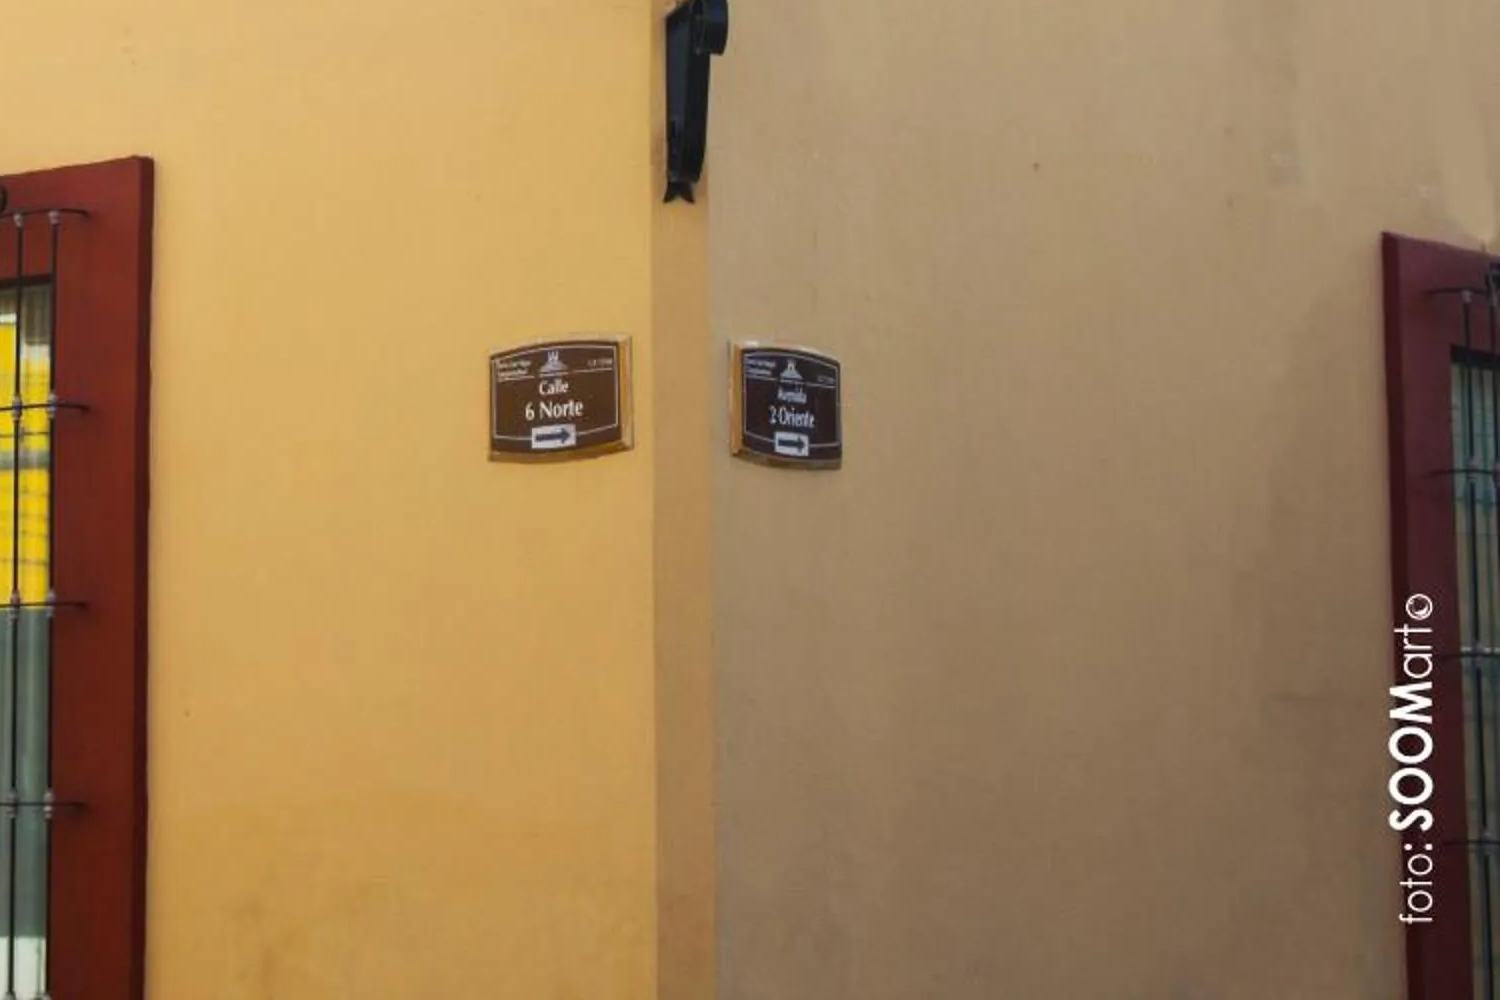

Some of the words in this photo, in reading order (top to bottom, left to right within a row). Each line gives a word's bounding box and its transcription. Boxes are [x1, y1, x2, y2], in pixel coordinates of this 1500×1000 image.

[539, 379, 569, 396] Calle
[525, 402, 535, 421] 6
[540, 400, 584, 420] Norte
[768, 405, 777, 425] 2
[778, 406, 815, 429] Oriente
